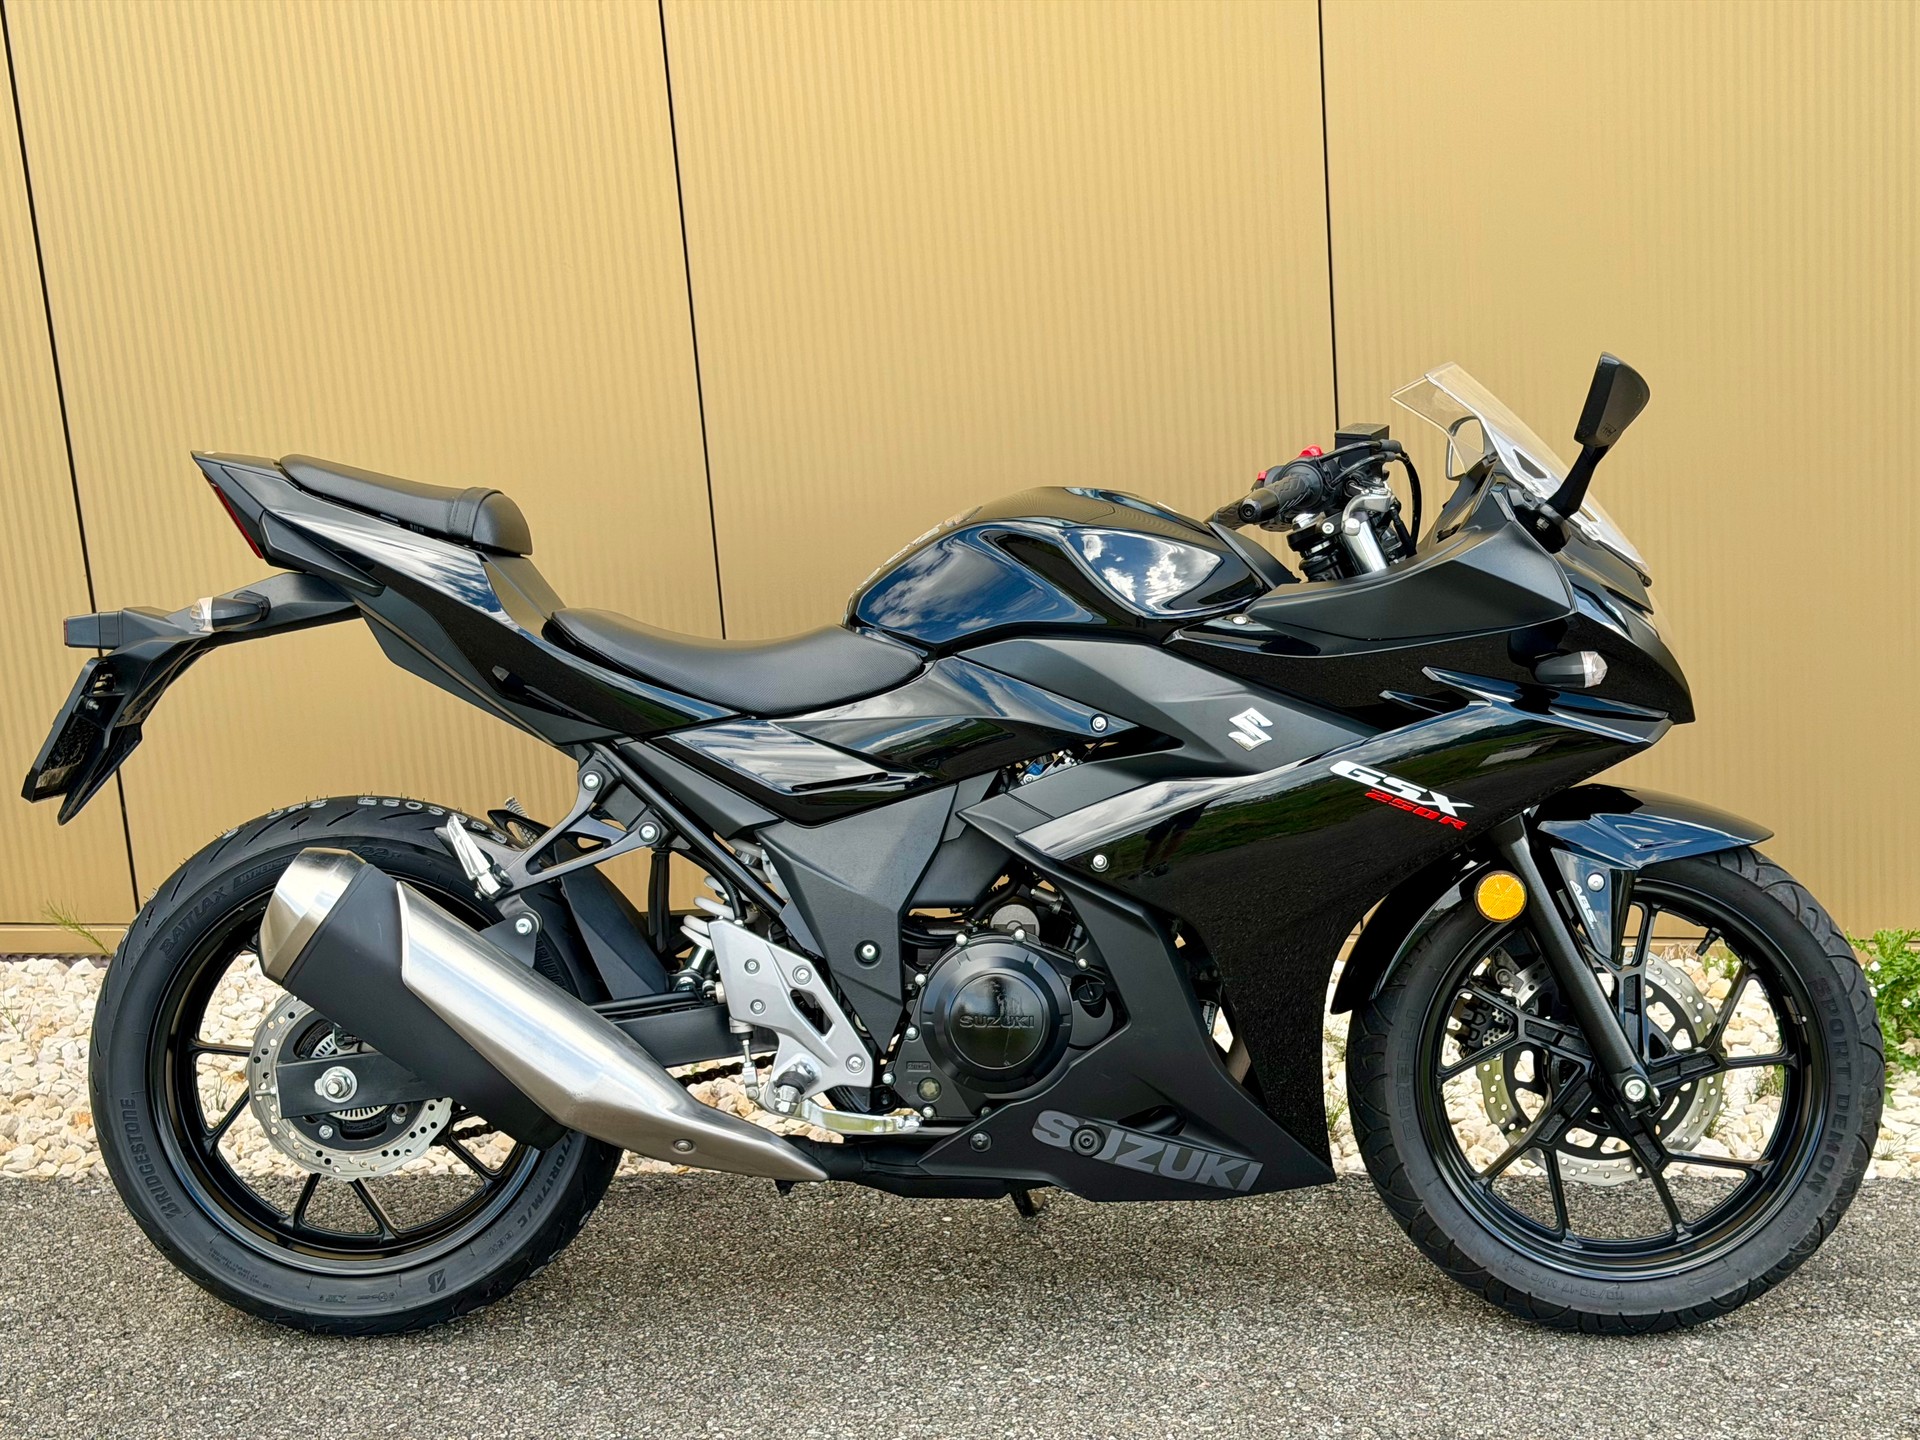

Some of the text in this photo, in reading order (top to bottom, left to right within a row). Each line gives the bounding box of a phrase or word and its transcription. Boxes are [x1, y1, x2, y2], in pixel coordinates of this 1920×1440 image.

[1329, 760, 1475, 818] GSX
[1364, 788, 1469, 831] 250R
[159, 886, 228, 957] BATTLAX
[1570, 880, 1598, 930] ABS
[959, 1014, 1035, 1029] SUZUKI
[1808, 976, 1852, 1080] SPORT
[1396, 1008, 1420, 1141] PIRELLI
[120, 1097, 183, 1220] BRIDGESTONE
[517, 1131, 574, 1228] /70R17M/C
[1806, 1093, 1850, 1195] DEMON
